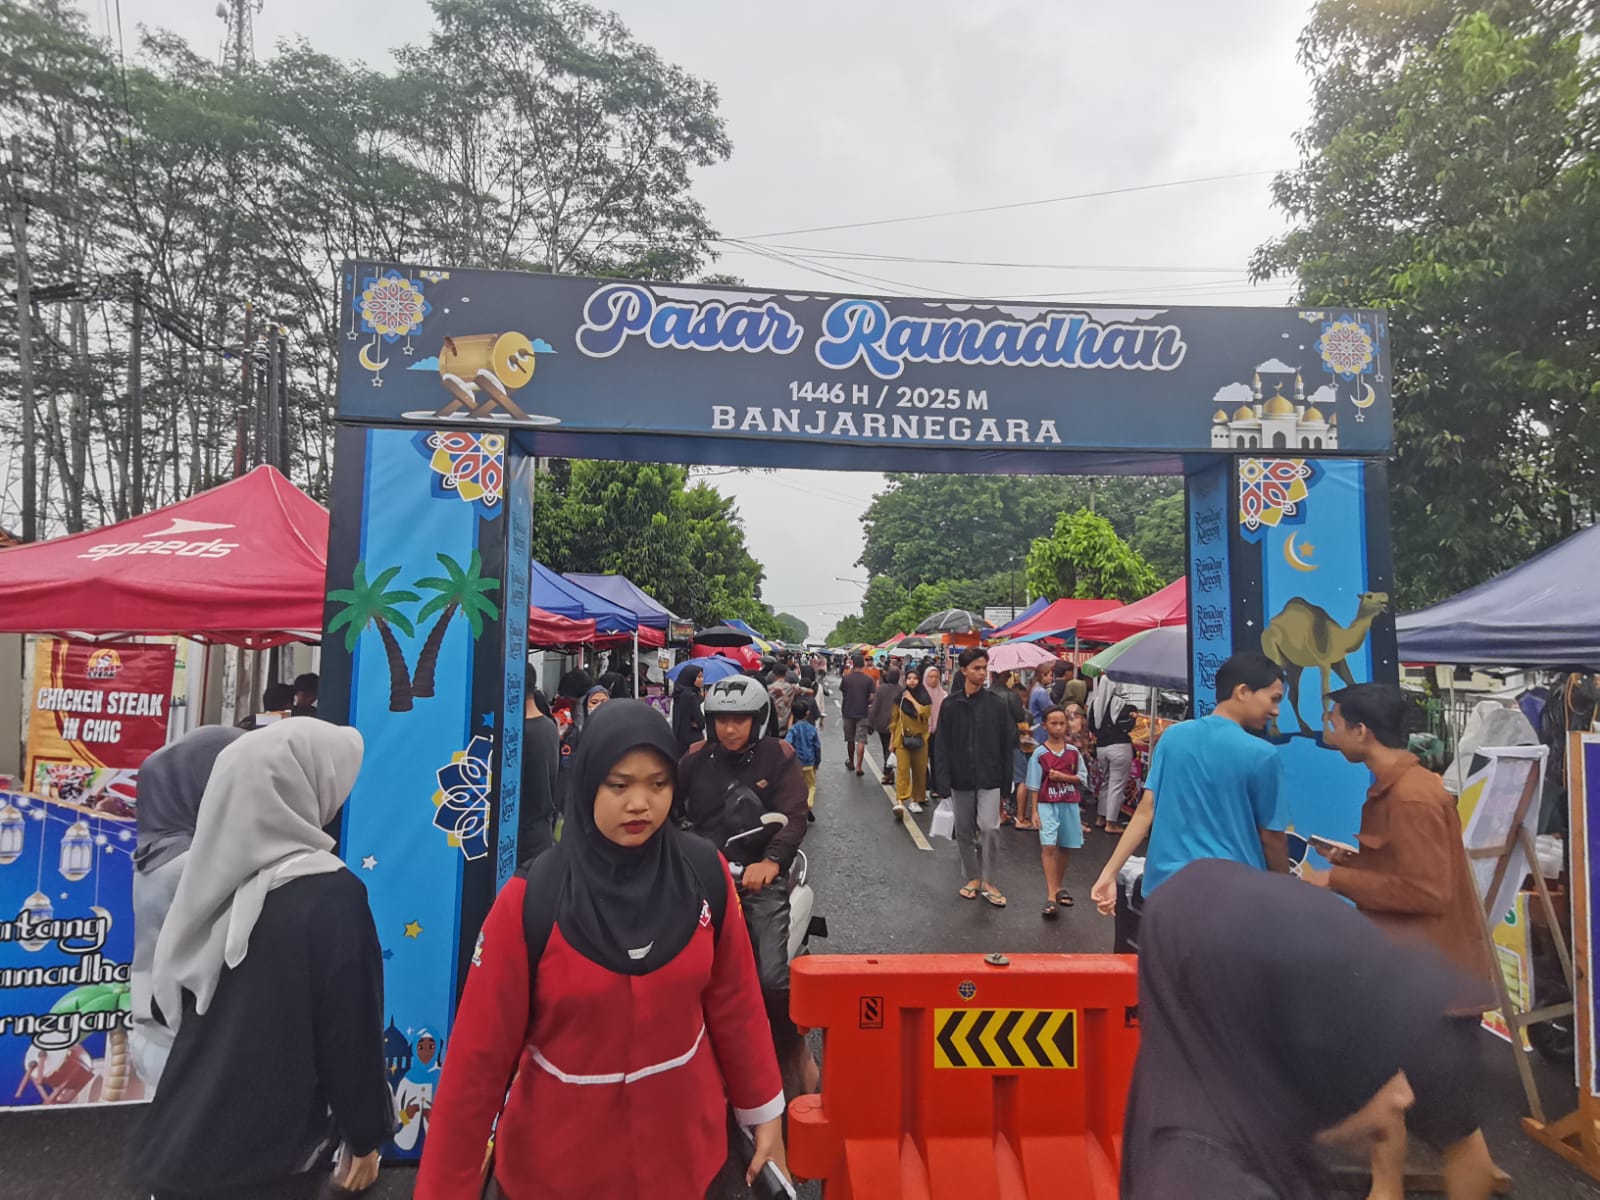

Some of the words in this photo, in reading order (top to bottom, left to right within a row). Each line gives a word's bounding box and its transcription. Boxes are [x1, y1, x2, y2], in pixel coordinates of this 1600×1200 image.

[576, 283, 804, 358] Pasar
[816, 298, 1187, 380] Ramadhan
[789, 381, 845, 405] 1446
[852, 385, 869, 406] H
[875, 385, 889, 409] /
[896, 386, 961, 411] 2025
[966, 390, 989, 411] M
[711, 405, 1062, 443] BANJARNEGARA
[76, 539, 240, 562] speeds
[37, 687, 104, 713] CHICKEN
[107, 691, 164, 717] STEAK
[62, 718, 80, 742] IN
[82, 718, 122, 744] CHIC
